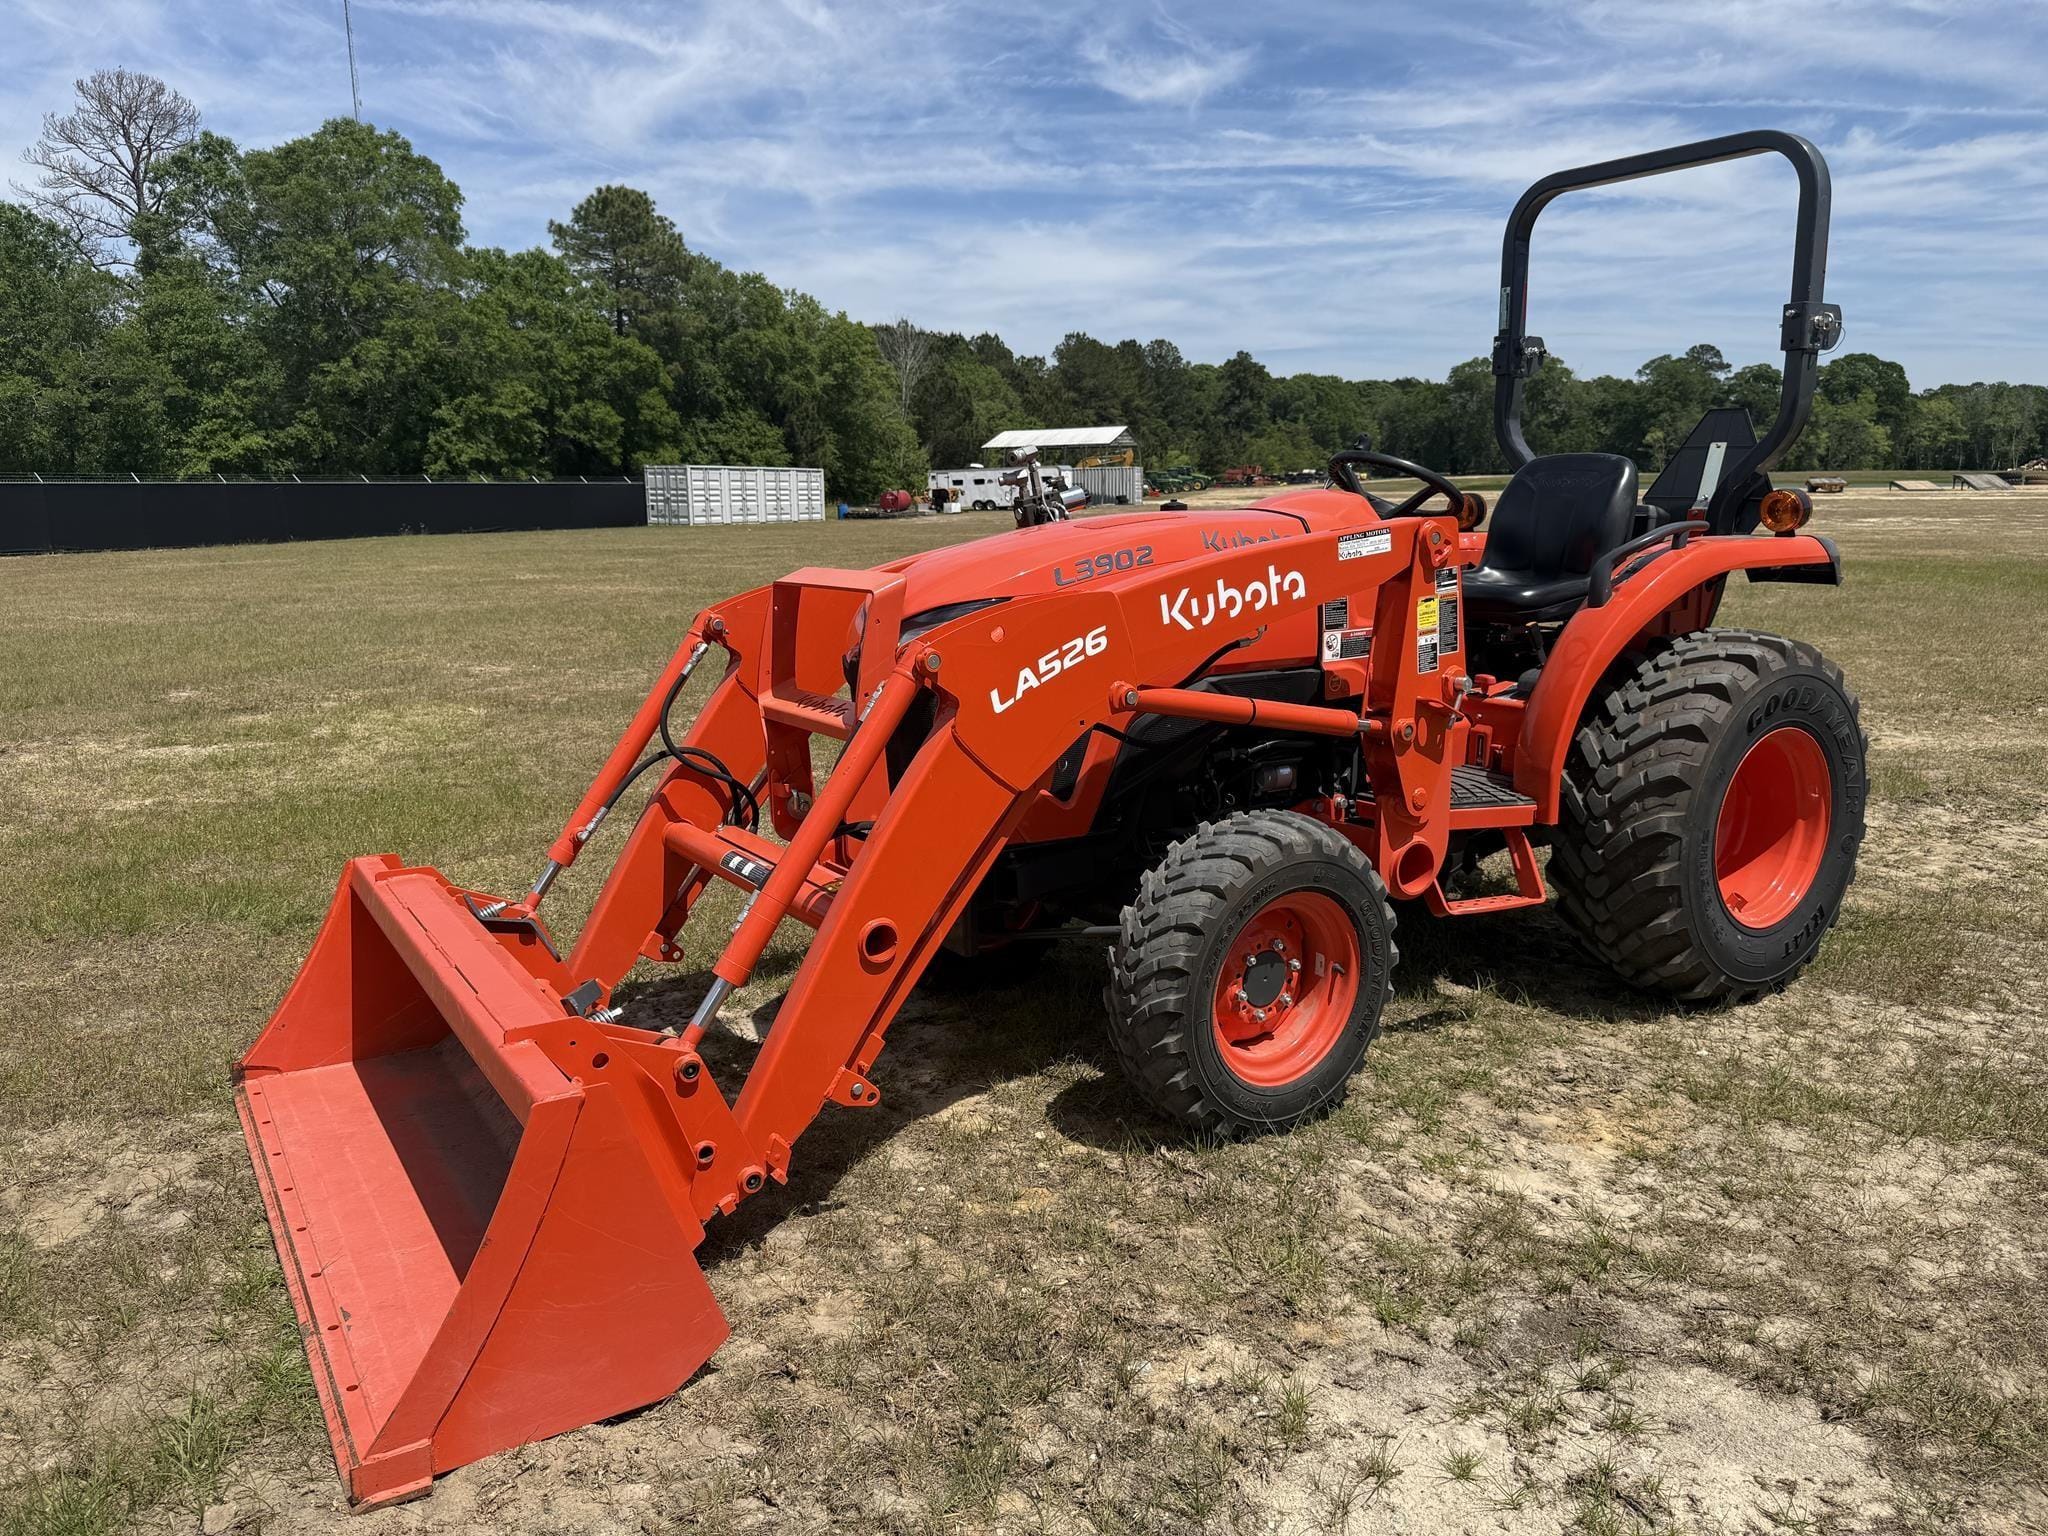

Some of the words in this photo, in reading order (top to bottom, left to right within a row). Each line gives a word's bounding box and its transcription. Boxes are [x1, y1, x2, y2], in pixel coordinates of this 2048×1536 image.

[1054, 545, 1154, 586] L3902
[1339, 532, 1365, 542] APPLING
[1366, 528, 1390, 537] MOTORS
[1160, 565, 1306, 631] Kubota
[990, 625, 1108, 714] LA526
[1747, 686, 1861, 815] GOODYEAR
